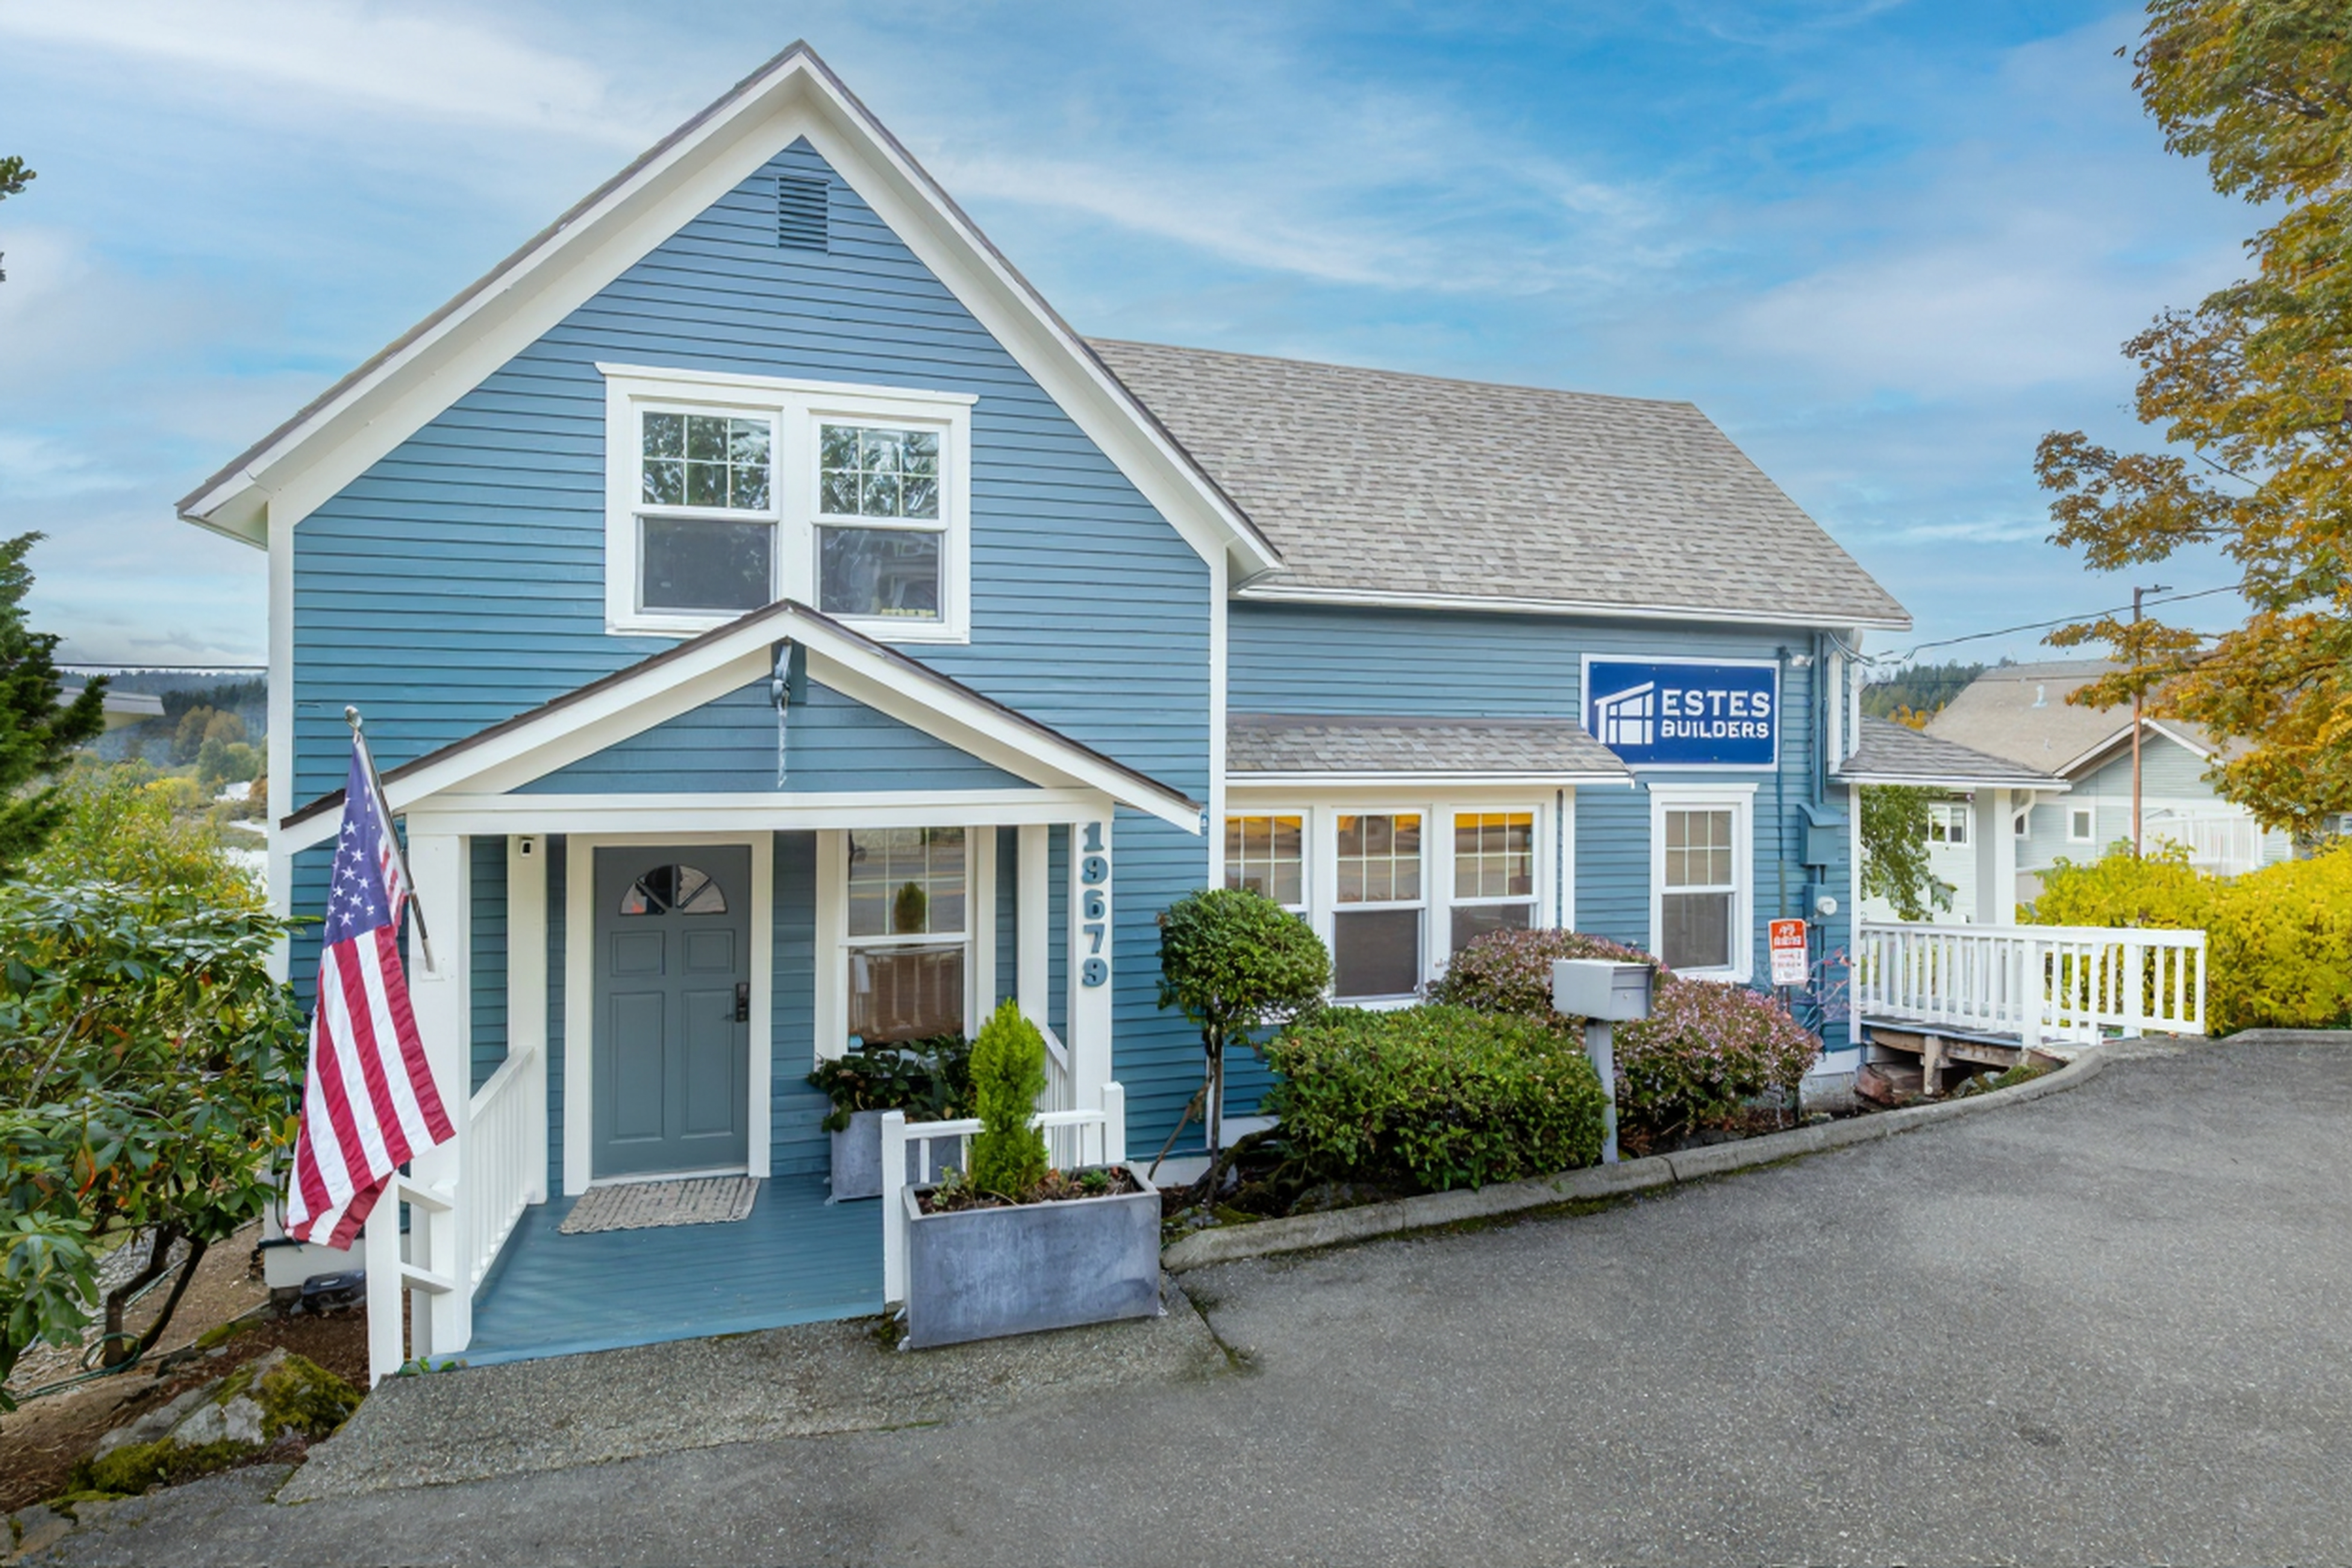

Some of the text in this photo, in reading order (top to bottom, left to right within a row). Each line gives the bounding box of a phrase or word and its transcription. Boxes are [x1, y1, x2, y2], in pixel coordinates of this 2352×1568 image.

[1662, 689, 1771, 718] ESTES
[1661, 720, 1769, 738] BUILDERS
[1081, 822, 1109, 987] 19679
